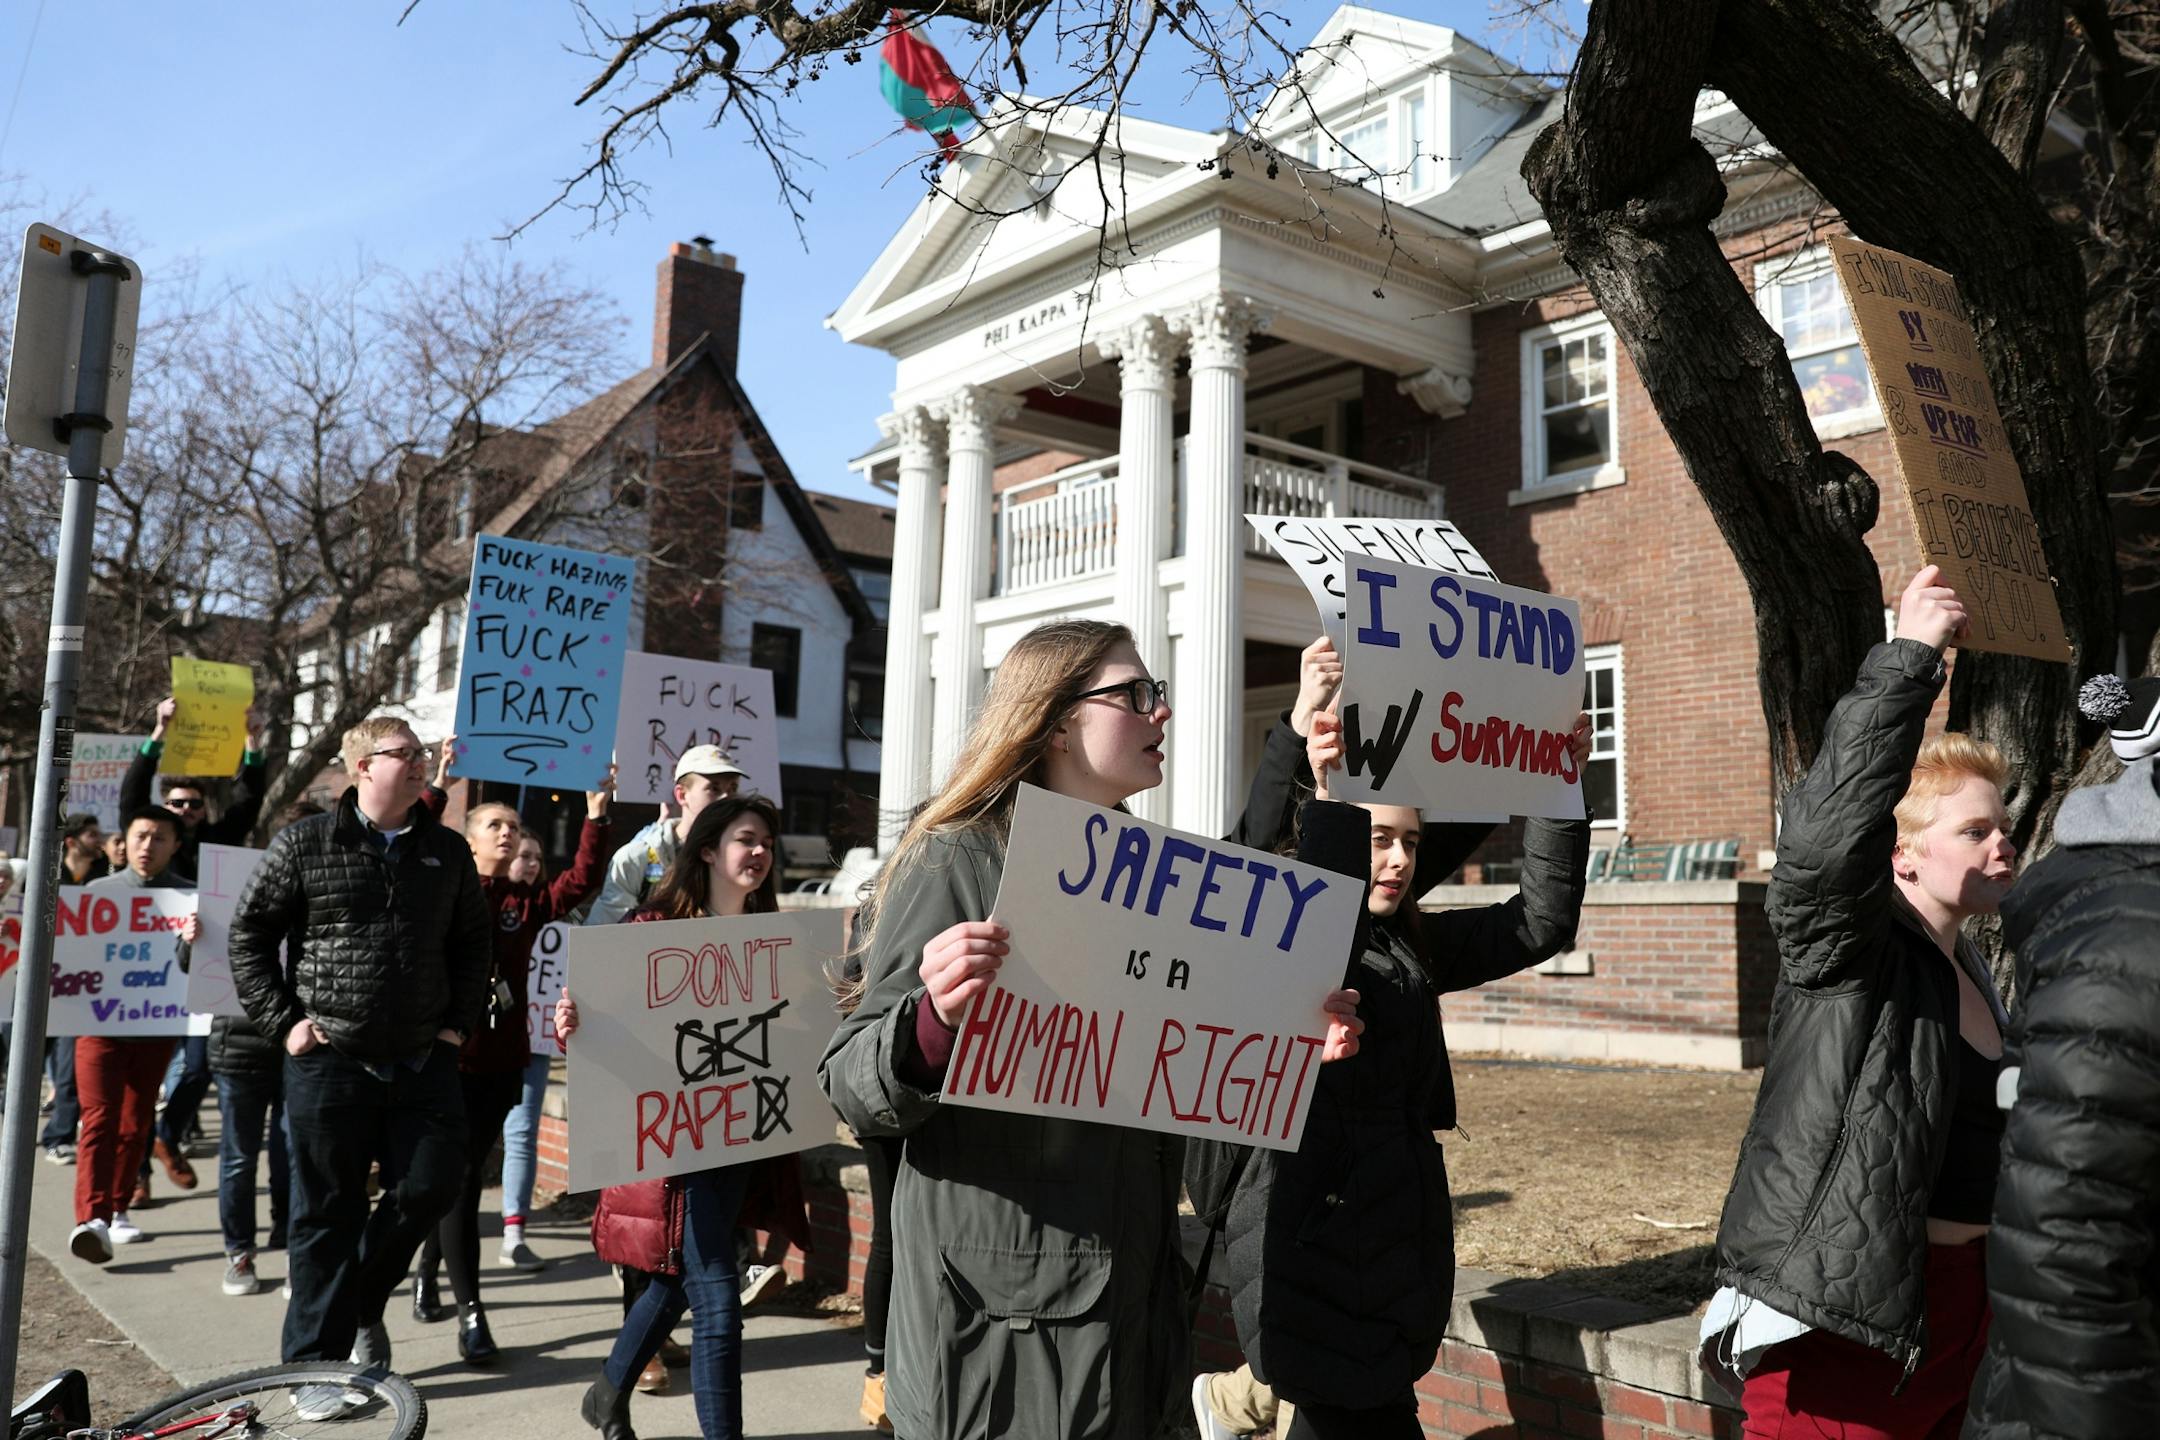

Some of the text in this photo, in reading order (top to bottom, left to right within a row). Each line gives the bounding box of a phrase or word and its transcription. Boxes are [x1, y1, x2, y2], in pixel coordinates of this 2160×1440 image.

[1842, 253, 1874, 294] I
[984, 324, 1010, 348] PHI
[1018, 303, 1067, 334] KAPPA
[1898, 310, 1971, 360] BY YOU
[1947, 371, 1989, 412] YOU
[1886, 385, 1918, 435] &
[1921, 402, 1951, 441] UP
[1948, 409, 1982, 448] FOR
[1937, 451, 1986, 488] AND
[1913, 488, 2049, 582] I BELIEVE
[481, 543, 628, 592] FUCK HAZING
[546, 586, 611, 622] RAPE
[1356, 568, 1401, 649] I
[475, 614, 590, 669] FUCK
[471, 672, 599, 734] FRATS
[659, 675, 758, 719] FUCK
[1057, 812, 1330, 952] SAFETY
[55, 894, 120, 937] NO
[105, 942, 153, 962] FOR
[122, 960, 173, 987] and
[647, 937, 793, 1009] DON'T
[1125, 949, 1191, 990] IS A
[91, 998, 194, 1022] Violenc
[947, 986, 1327, 1141] HUMAN RIGHT
